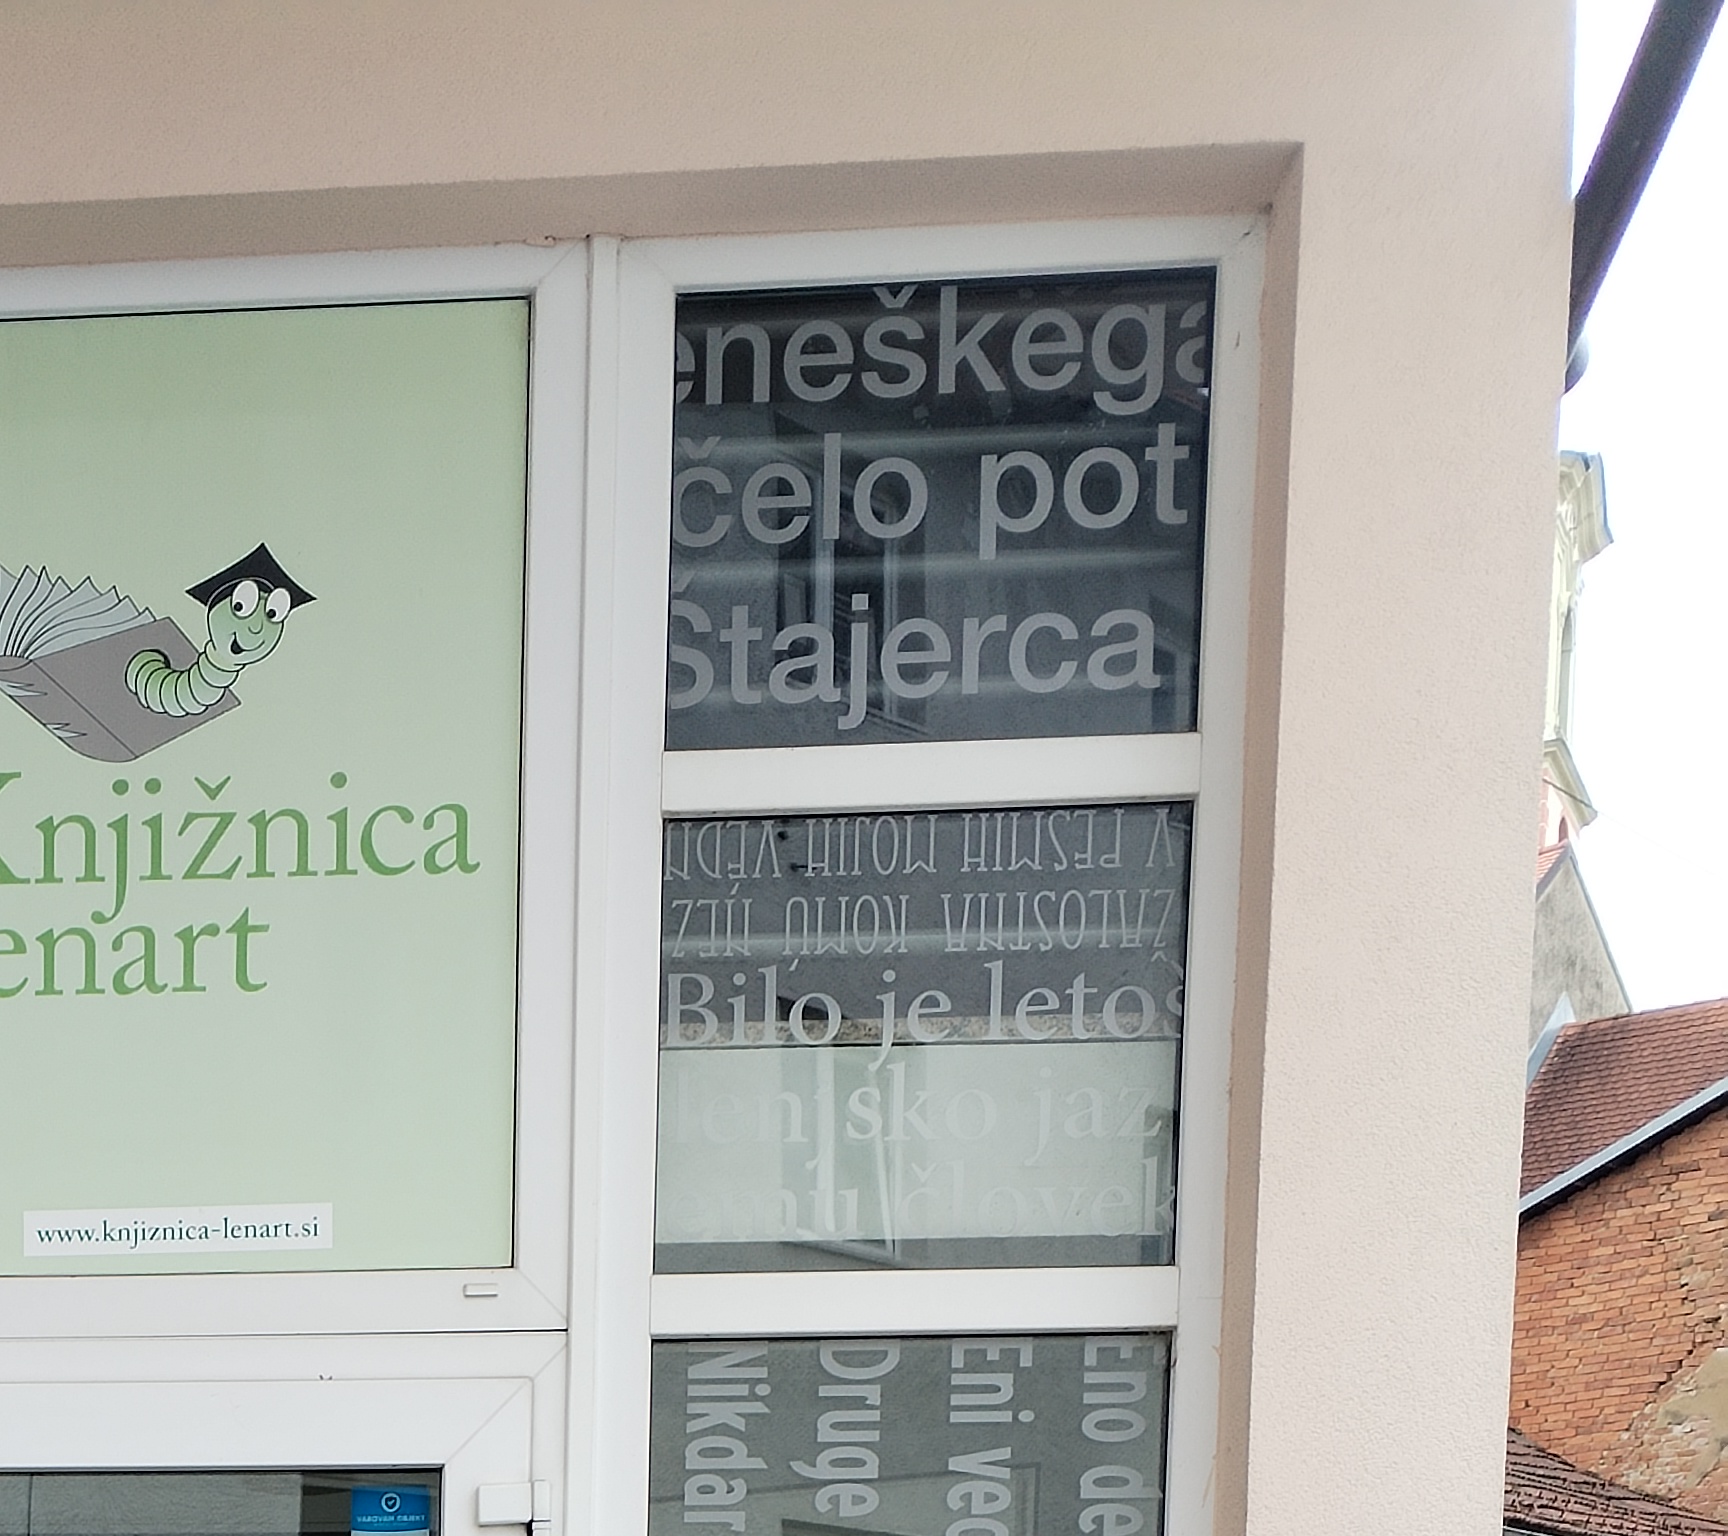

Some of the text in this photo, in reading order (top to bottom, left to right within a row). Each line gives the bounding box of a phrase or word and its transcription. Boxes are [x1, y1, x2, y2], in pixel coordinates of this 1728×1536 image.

[979, 422, 1190, 560] pot
[806, 815, 937, 877] MOJIH
[961, 809, 1123, 873] PESMIH
[941, 888, 1175, 962] ŽALOSTNA
[666, 965, 952, 1071] Bilo je
[36, 1216, 320, 1249] www.knjiznica-lenart.si
[950, 1338, 1035, 1424] Eni
[1082, 1338, 1166, 1442] Eno
[683, 1342, 771, 1533] Nikdar
[789, 1340, 899, 1518] Druge
